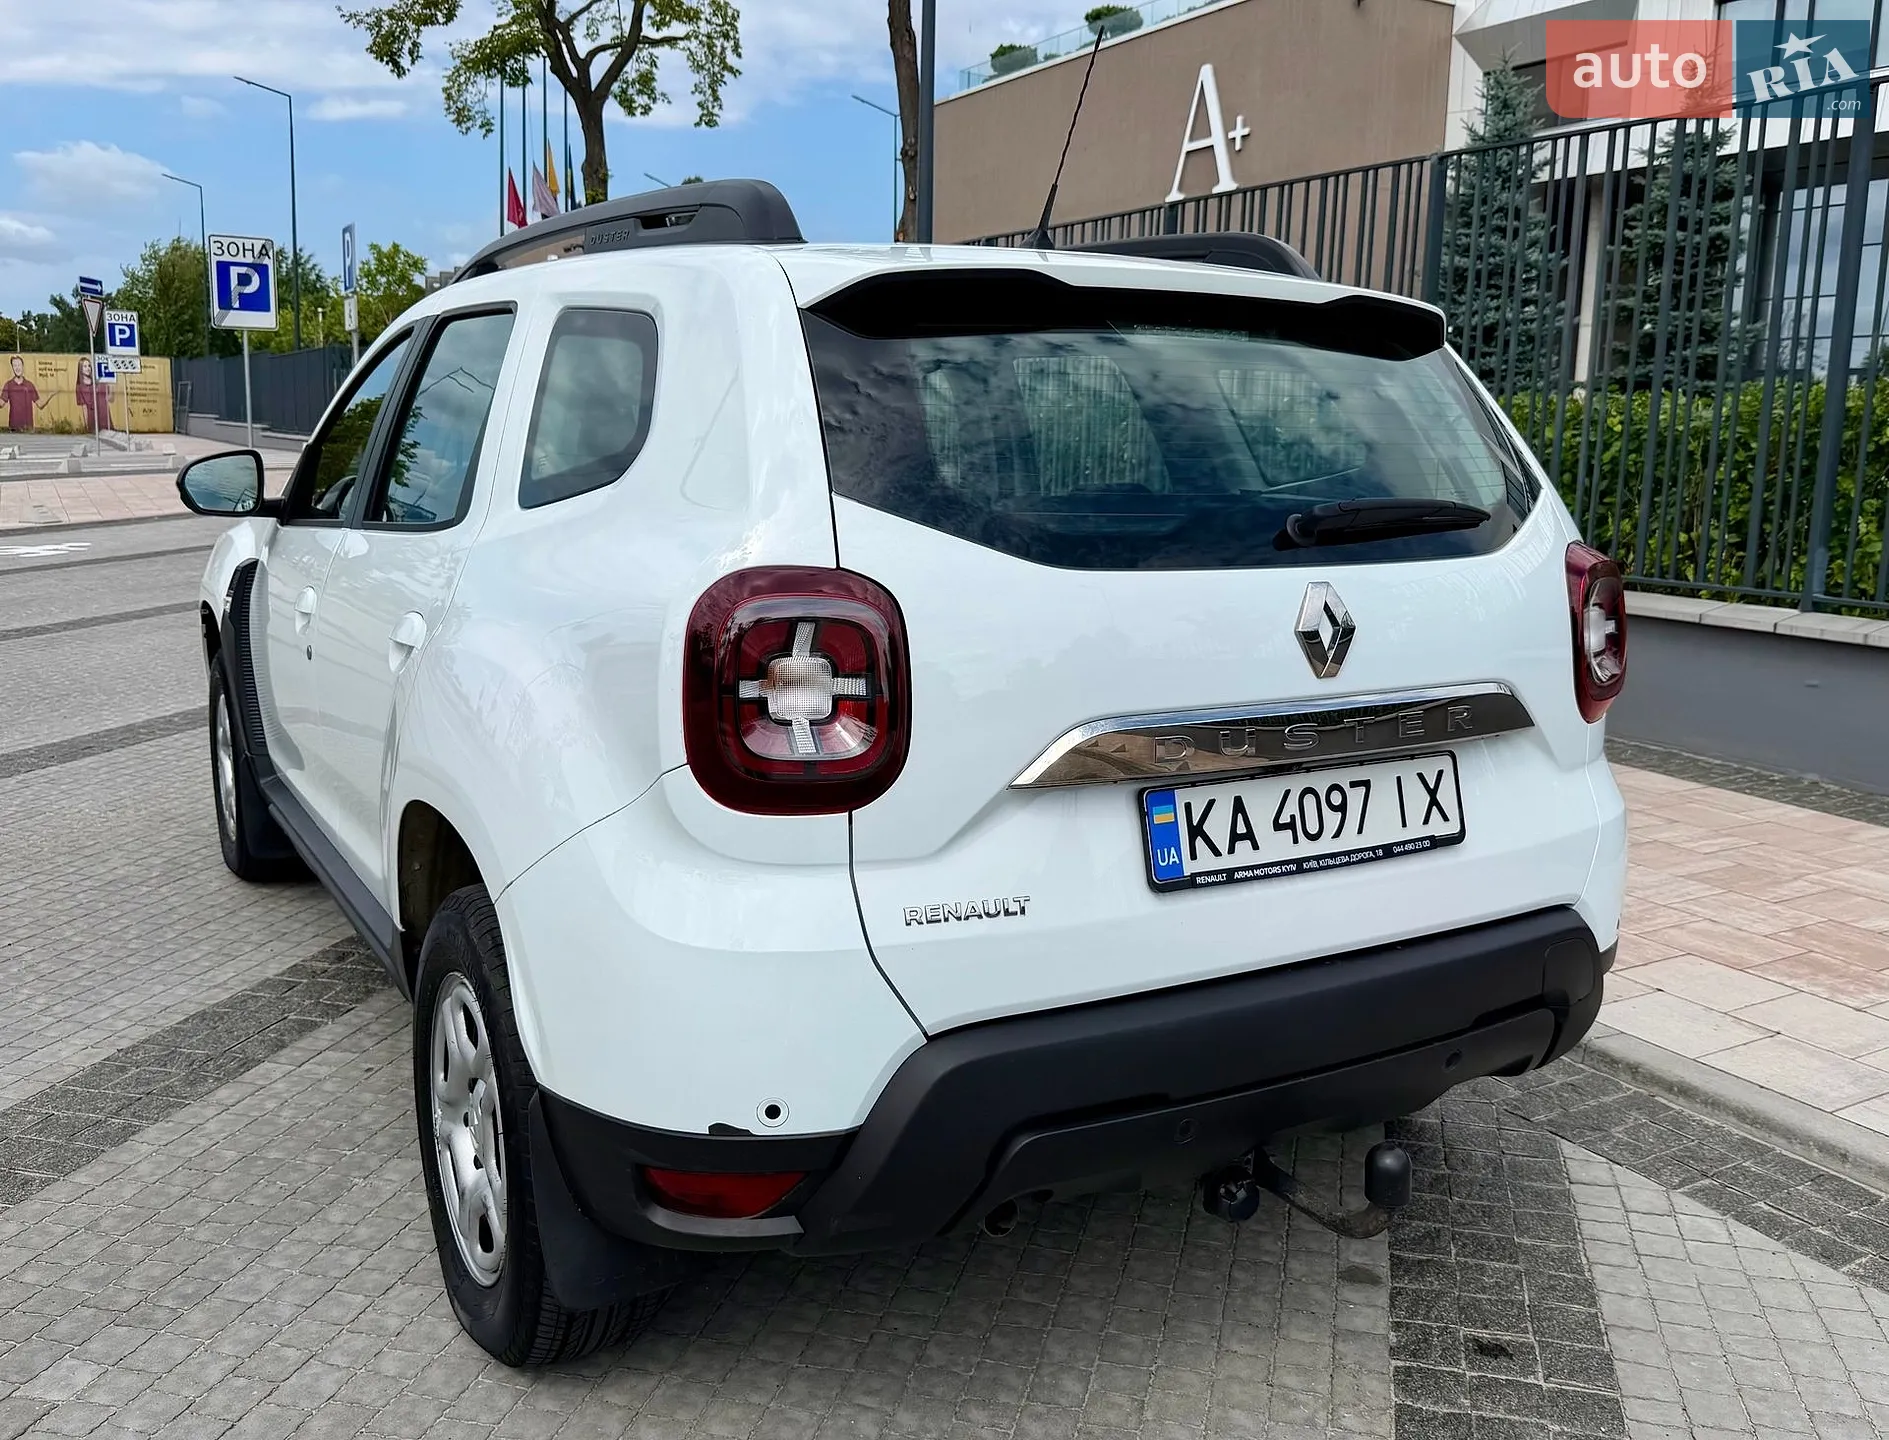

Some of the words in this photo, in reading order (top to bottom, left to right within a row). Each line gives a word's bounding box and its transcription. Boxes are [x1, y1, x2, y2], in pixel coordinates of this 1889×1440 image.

[590, 229, 630, 245] DUSTER
[212, 240, 271, 260] ЗОНА
[229, 265, 261, 309] P
[106, 313, 136, 322] ЗОНА
[114, 324, 131, 346] P
[1154, 705, 1474, 764] DUSTER
[1184, 795, 1260, 861] KA
[1272, 778, 1371, 845] 4097
[1396, 768, 1450, 829] IX
[1157, 848, 1180, 868] UA
[1392, 845, 1404, 853] 044
[1195, 873, 1227, 885] RENAULT
[1233, 870, 1254, 879] ARMA
[1253, 865, 1282, 876] MOTORS
[1281, 863, 1297, 873] KYIV
[903, 895, 1031, 927] RENAULT
